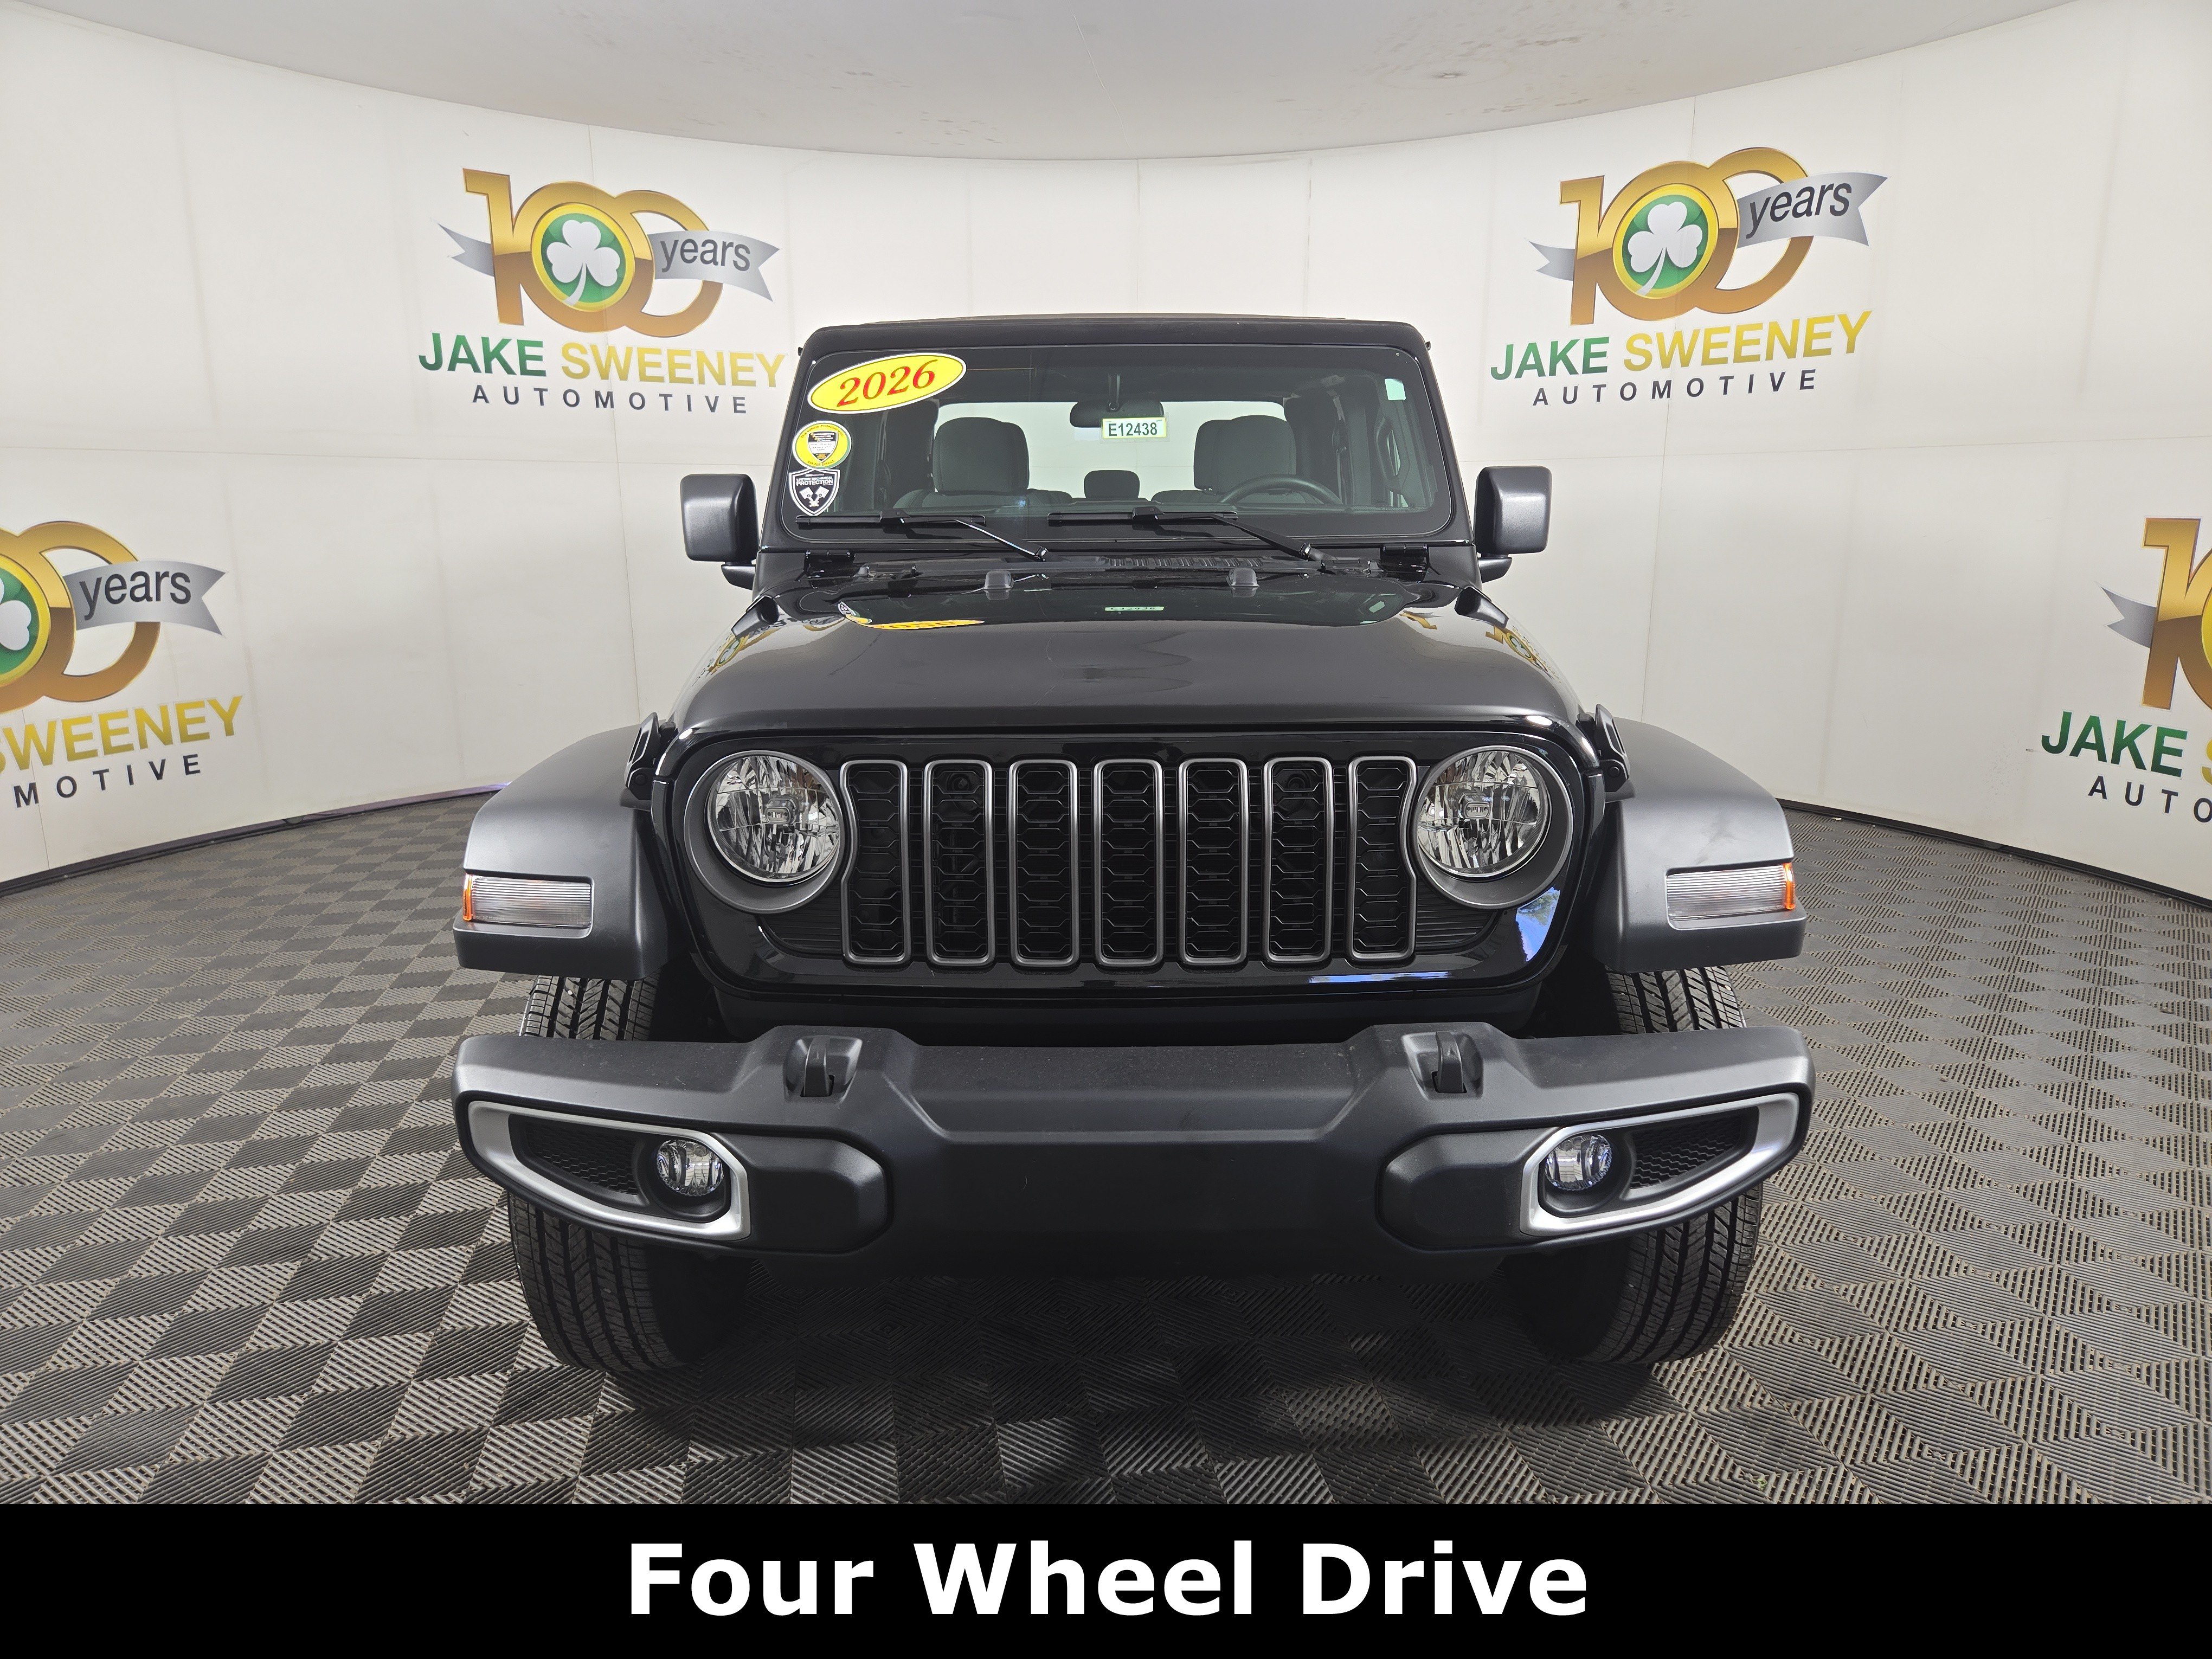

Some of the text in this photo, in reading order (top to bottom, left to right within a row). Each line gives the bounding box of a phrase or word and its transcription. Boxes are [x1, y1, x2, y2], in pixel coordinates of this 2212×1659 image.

[1560, 146, 1814, 325] 100
[1746, 183, 1852, 239] years
[463, 168, 724, 337] 100
[660, 238, 751, 272] years
[419, 332, 786, 388] JAKE SWEENEY
[1490, 311, 1873, 381] JAKE SWEENEY
[473, 384, 747, 414] AUTOMOTIVE
[837, 359, 938, 407] 2026
[1532, 369, 1817, 407] AUTOMOTIVE
[1108, 422, 1158, 436] E12438
[79, 571, 191, 621] years
[0, 695, 242, 774] WEENEY
[2041, 711, 2188, 778] JAKE
